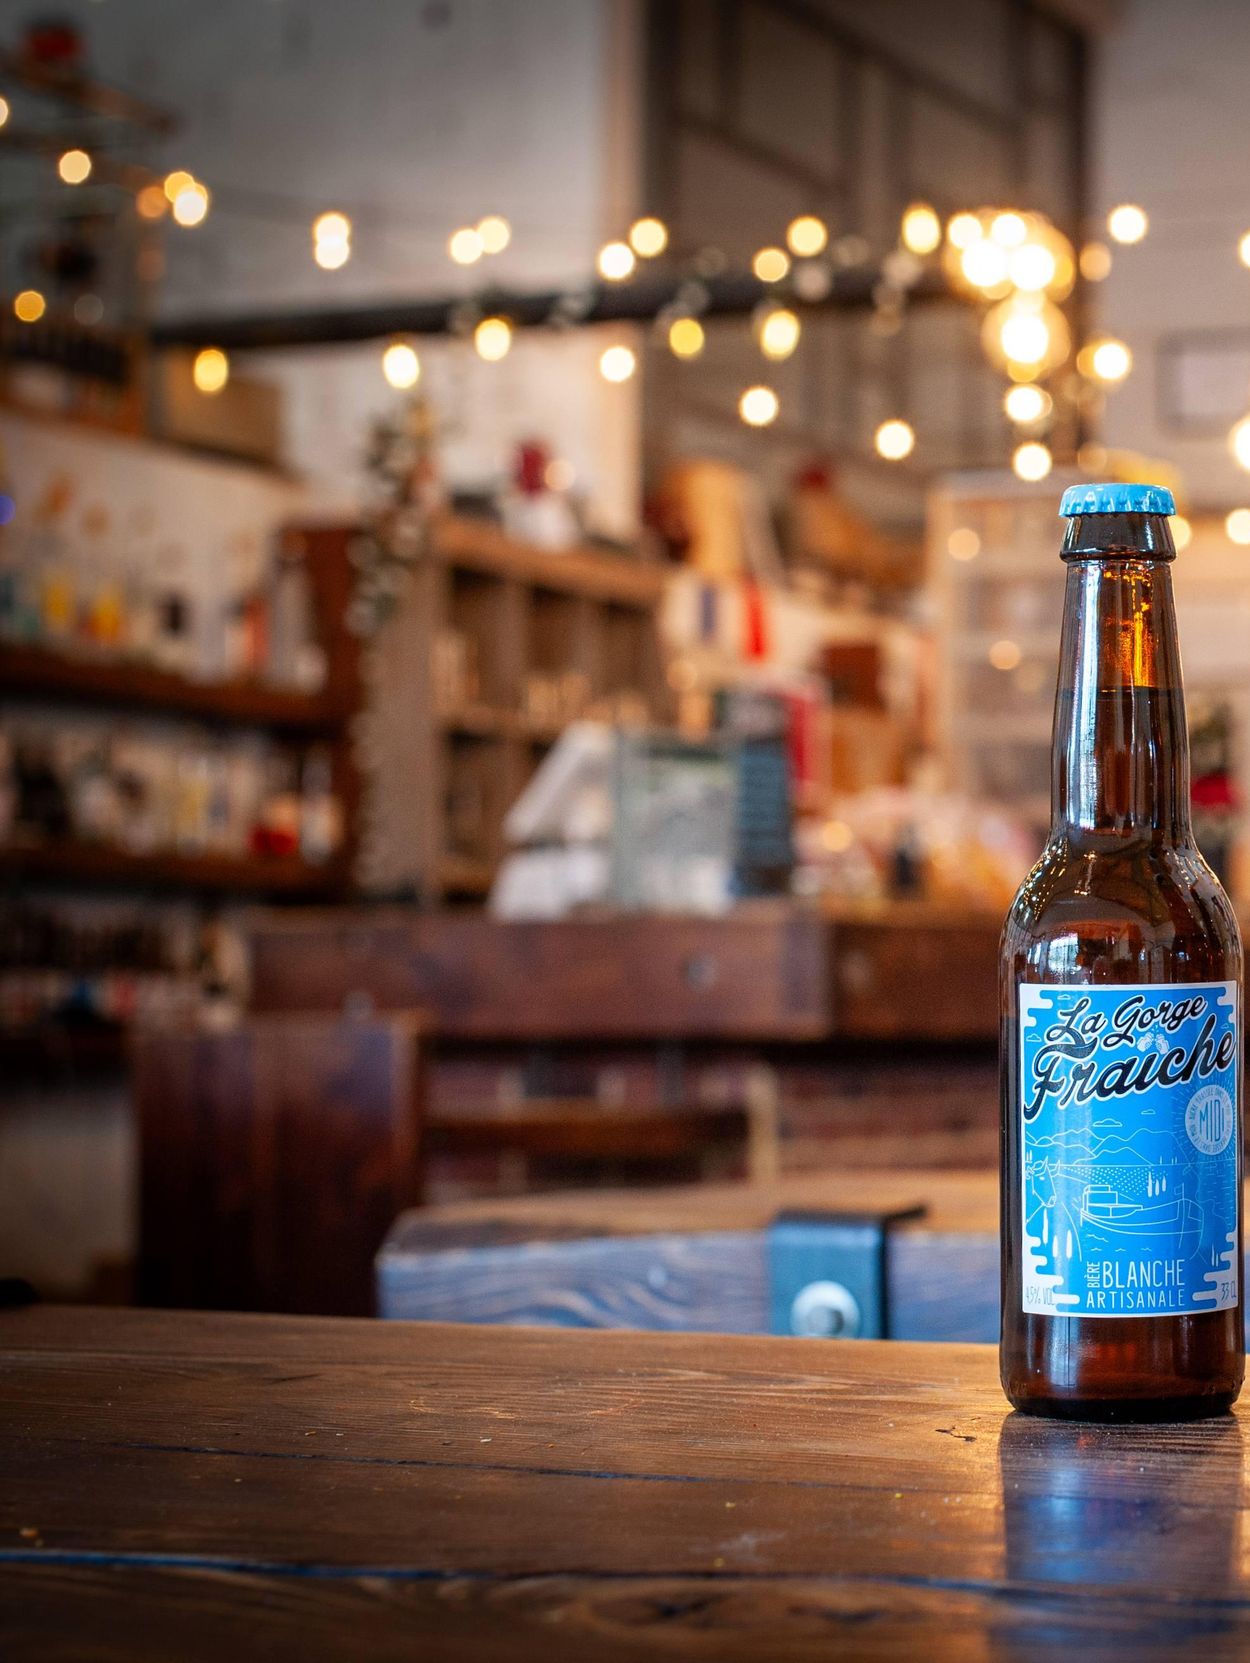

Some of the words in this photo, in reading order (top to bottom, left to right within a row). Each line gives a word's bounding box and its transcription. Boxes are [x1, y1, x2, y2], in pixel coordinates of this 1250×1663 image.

[1047, 996, 1105, 1042] La
[1104, 994, 1208, 1046] Gorge
[1199, 1099, 1225, 1142] MIDI
[1103, 1259, 1186, 1289] BLANCHE
[1086, 1288, 1186, 1309] ARTISANALE
